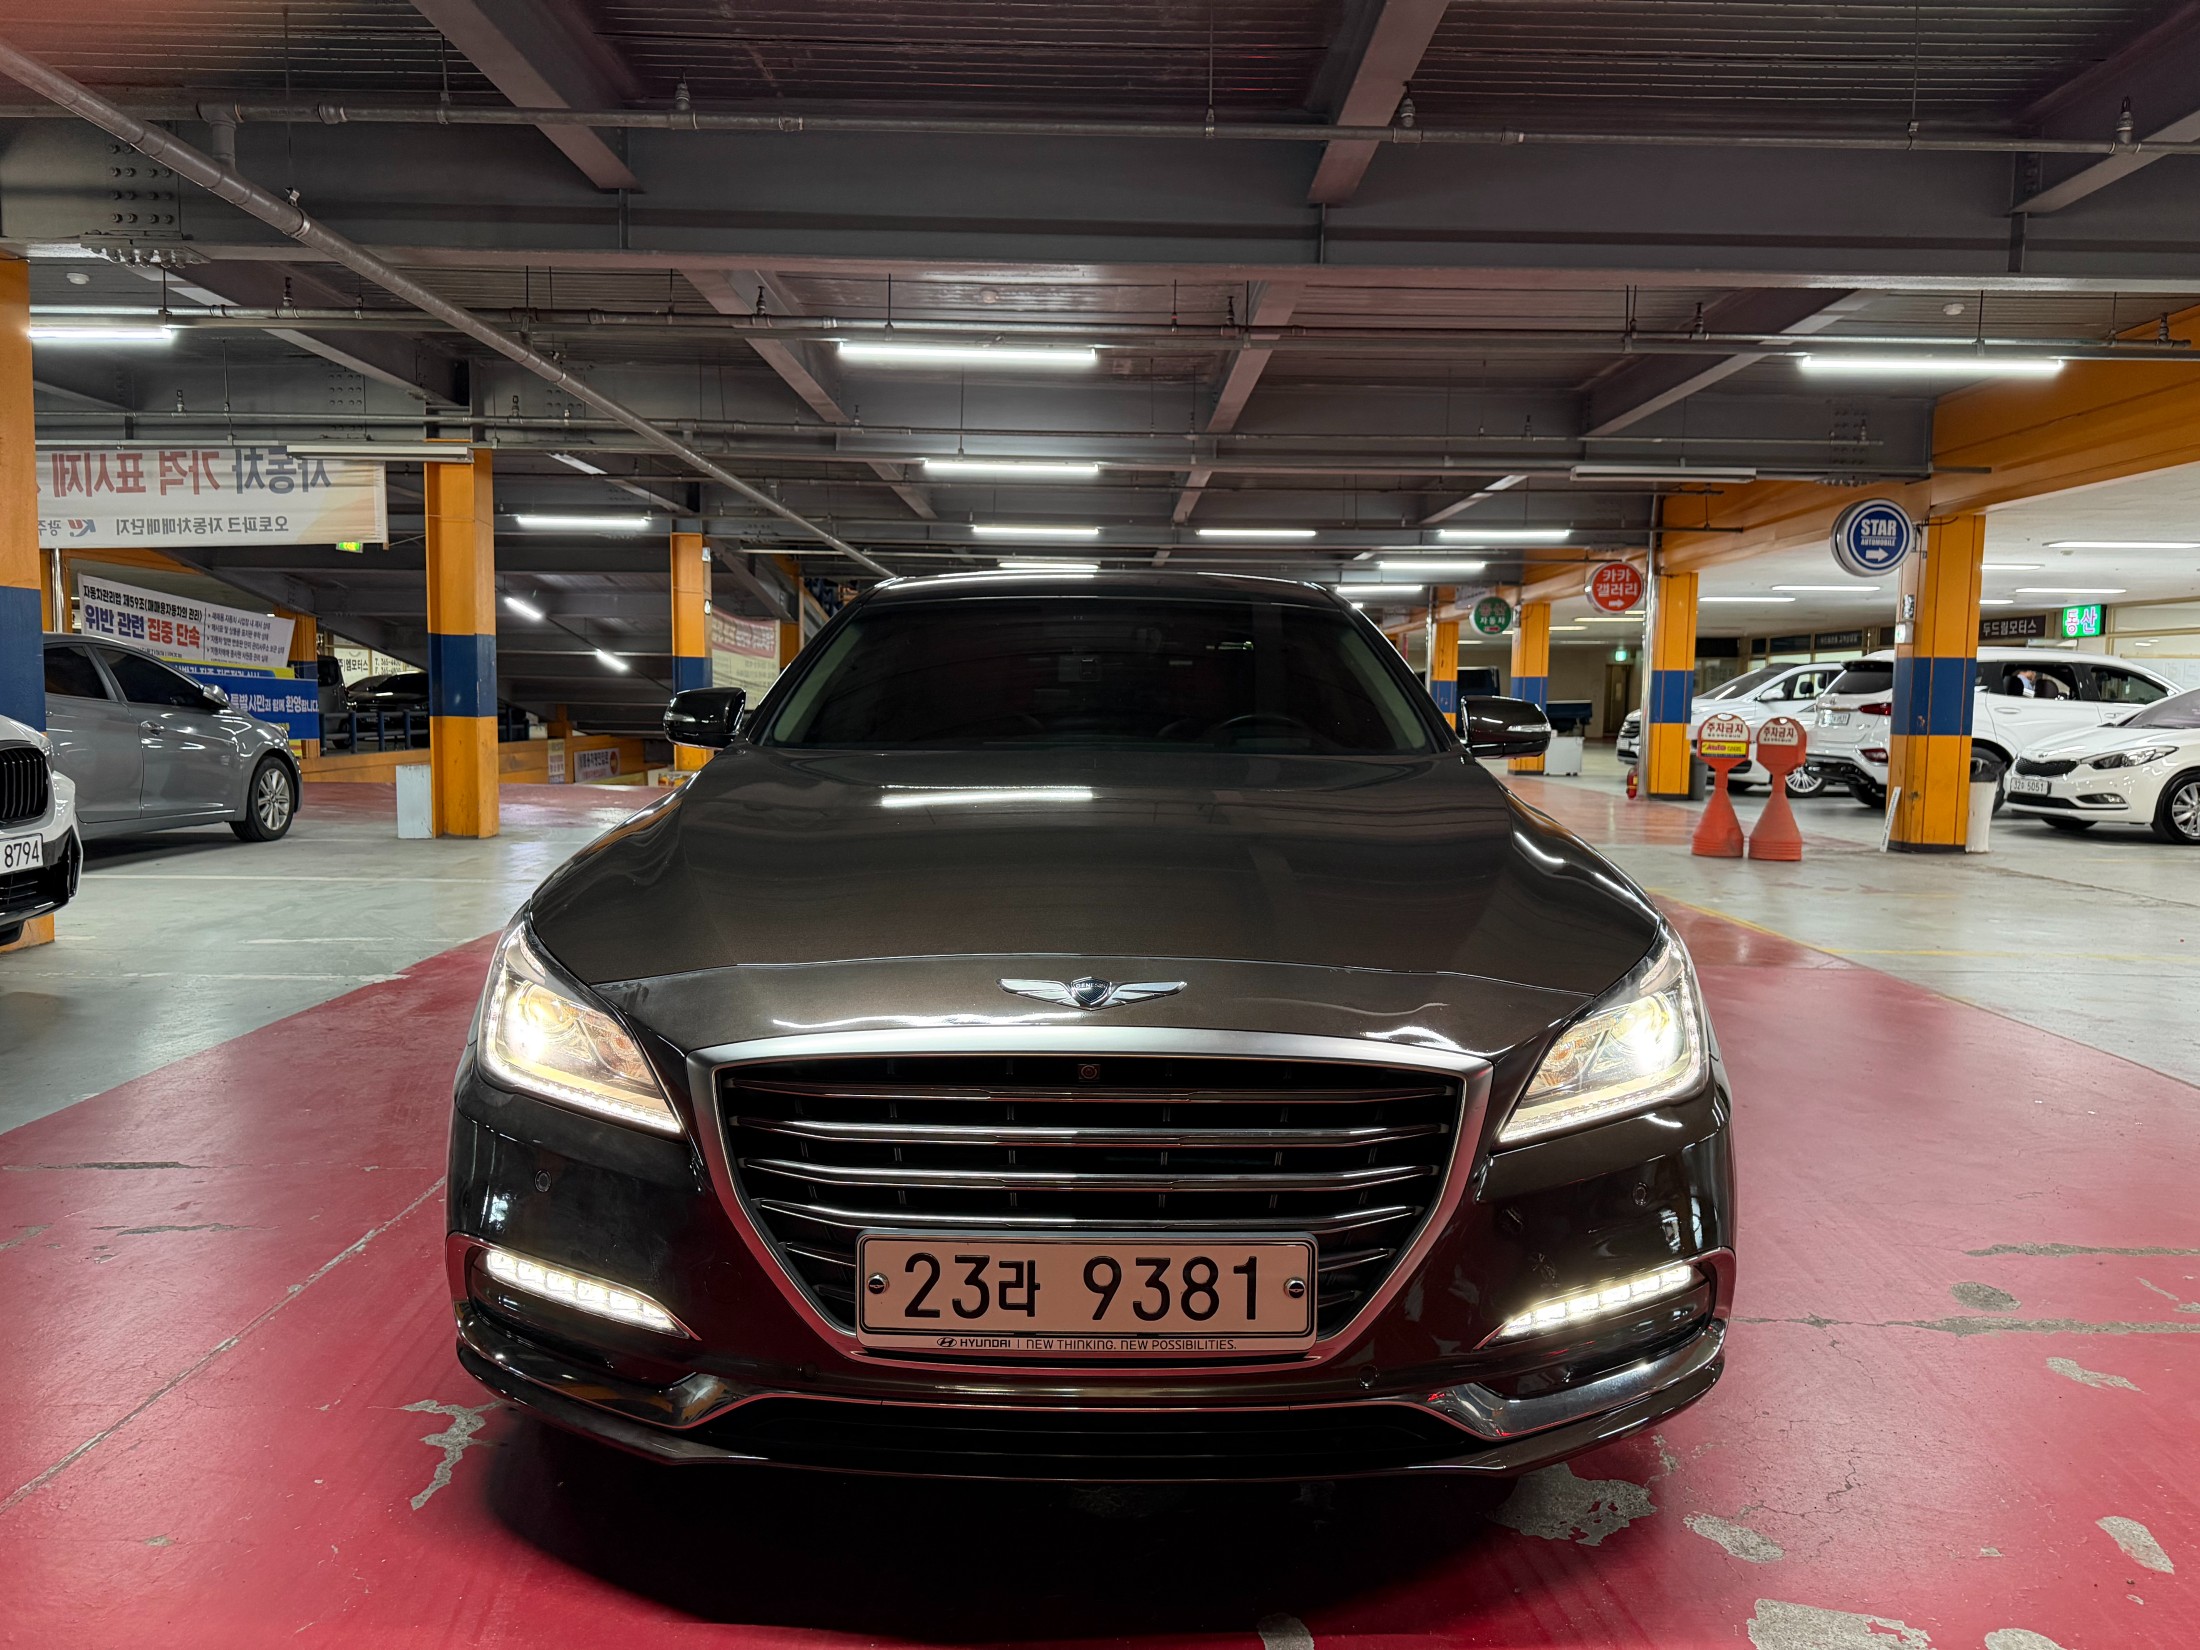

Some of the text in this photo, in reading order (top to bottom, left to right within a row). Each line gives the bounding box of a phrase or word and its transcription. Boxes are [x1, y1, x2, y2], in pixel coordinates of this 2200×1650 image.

[1861, 518, 1897, 536] STAR
[1861, 537, 1895, 547] AUTOMOBILE
[1603, 568, 1631, 582] 카카
[83, 585, 121, 605] 자동차관리법
[1596, 582, 1638, 597] 갤러리
[84, 604, 200, 649] 위반 관련 집중 단속
[1983, 619, 2037, 636] 두드림모터스
[2065, 606, 2097, 636] 동산
[1707, 722, 1743, 734] 주차금지
[1763, 727, 1794, 738] 주차금지
[4, 840, 40, 868] 8794
[904, 1252, 1258, 1322] 23라 9381
[960, 1338, 1011, 1348] HYUNDAI
[1026, 1339, 1237, 1351] NEW THINKING. NEW POSSIBILITIES.
